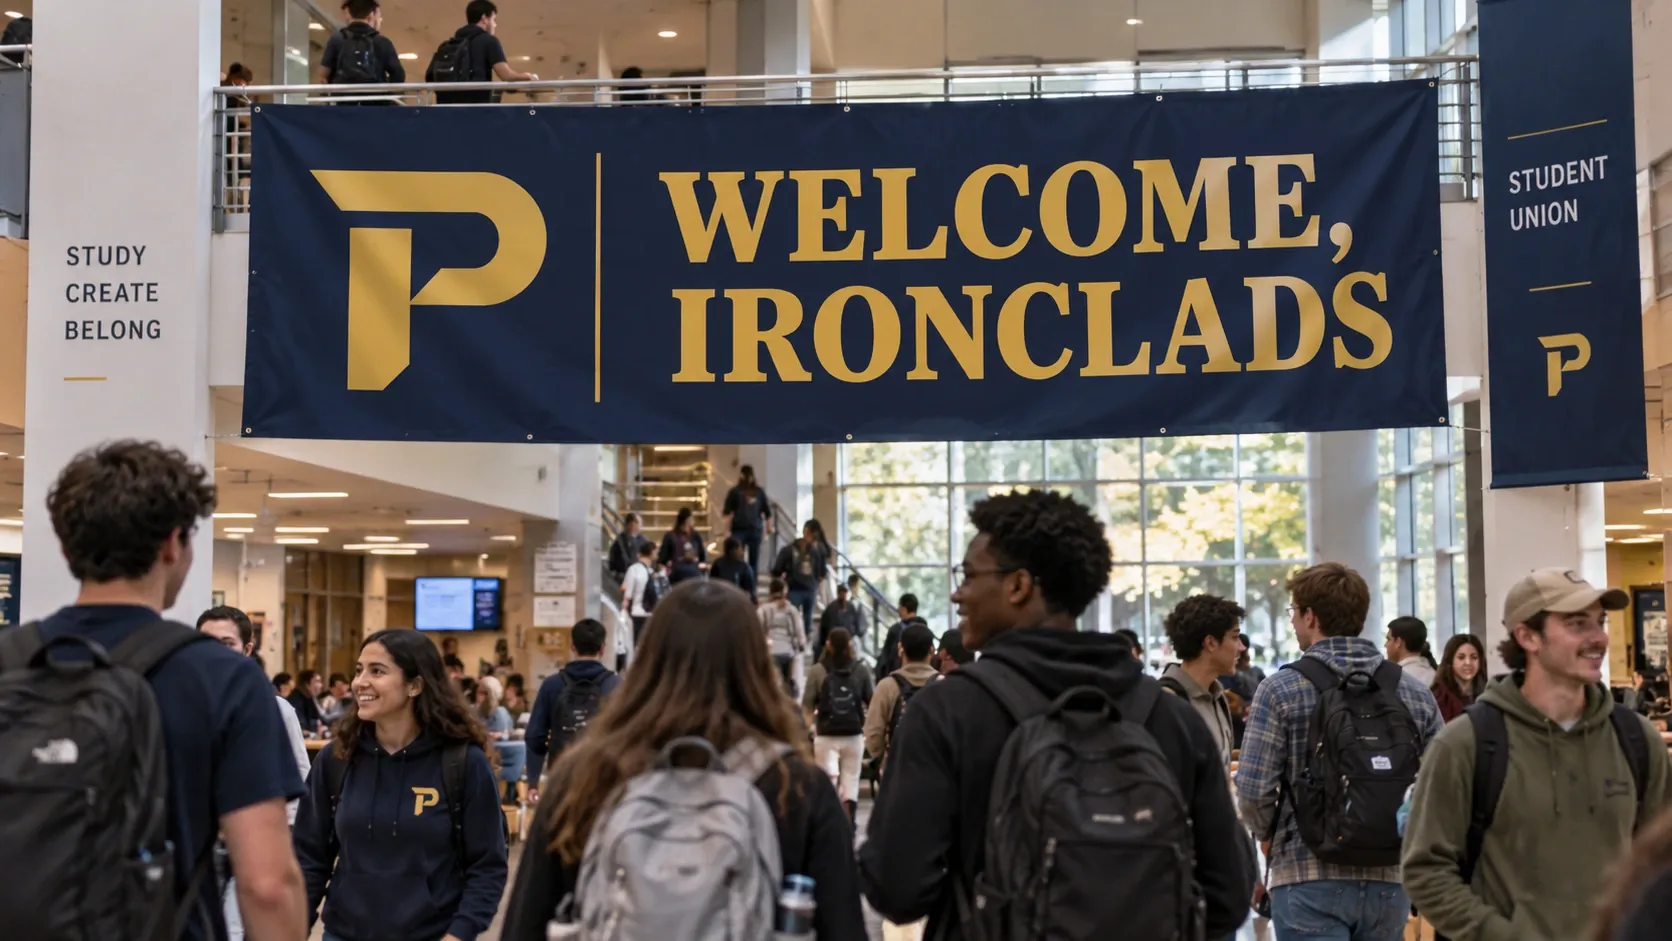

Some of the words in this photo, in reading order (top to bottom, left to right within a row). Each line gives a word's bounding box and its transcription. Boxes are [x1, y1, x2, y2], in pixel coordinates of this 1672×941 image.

[1509, 155, 1608, 194] STUDENT
[658, 153, 1354, 265] WELCOME,
[1510, 199, 1578, 231] UNION
[66, 246, 147, 267] STUDY
[65, 282, 159, 304] CREATE
[309, 169, 548, 392] P
[65, 319, 161, 341] BELONG
[671, 271, 1394, 384] IRONCLADS
[1538, 332, 1592, 397] P
